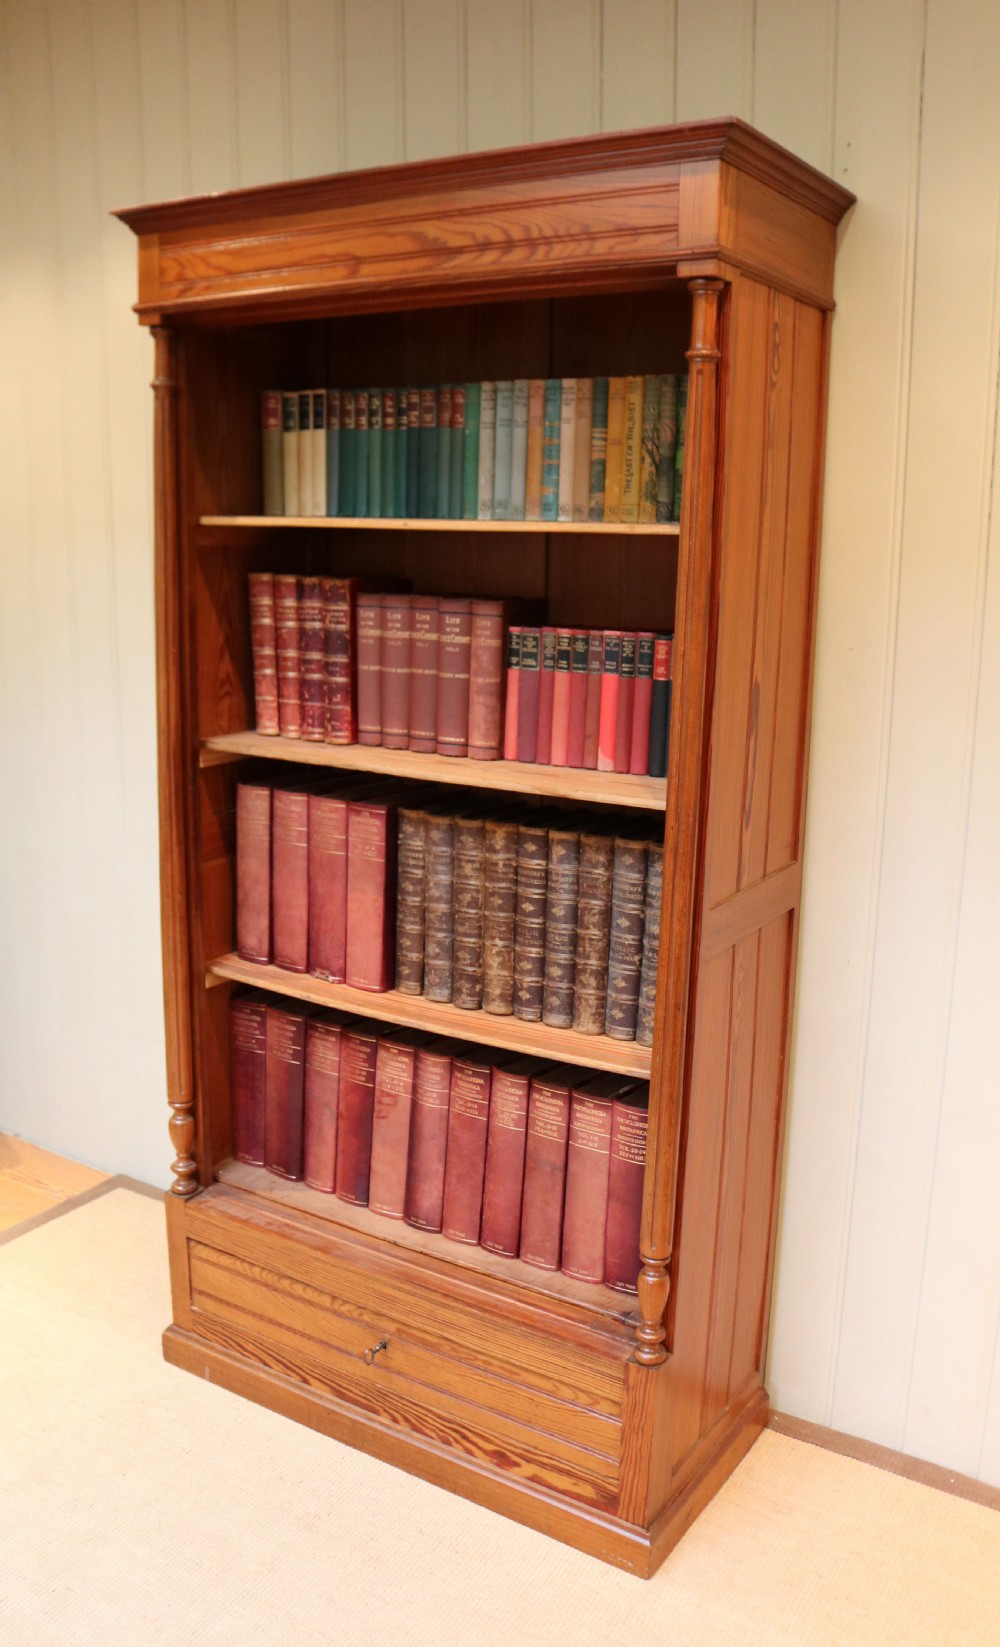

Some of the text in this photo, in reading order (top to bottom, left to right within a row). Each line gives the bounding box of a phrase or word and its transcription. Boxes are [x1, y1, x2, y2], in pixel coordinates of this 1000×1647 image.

[627, 402, 636, 426] JUST
[625, 459, 634, 478] LAST
[624, 479, 633, 496] THE
